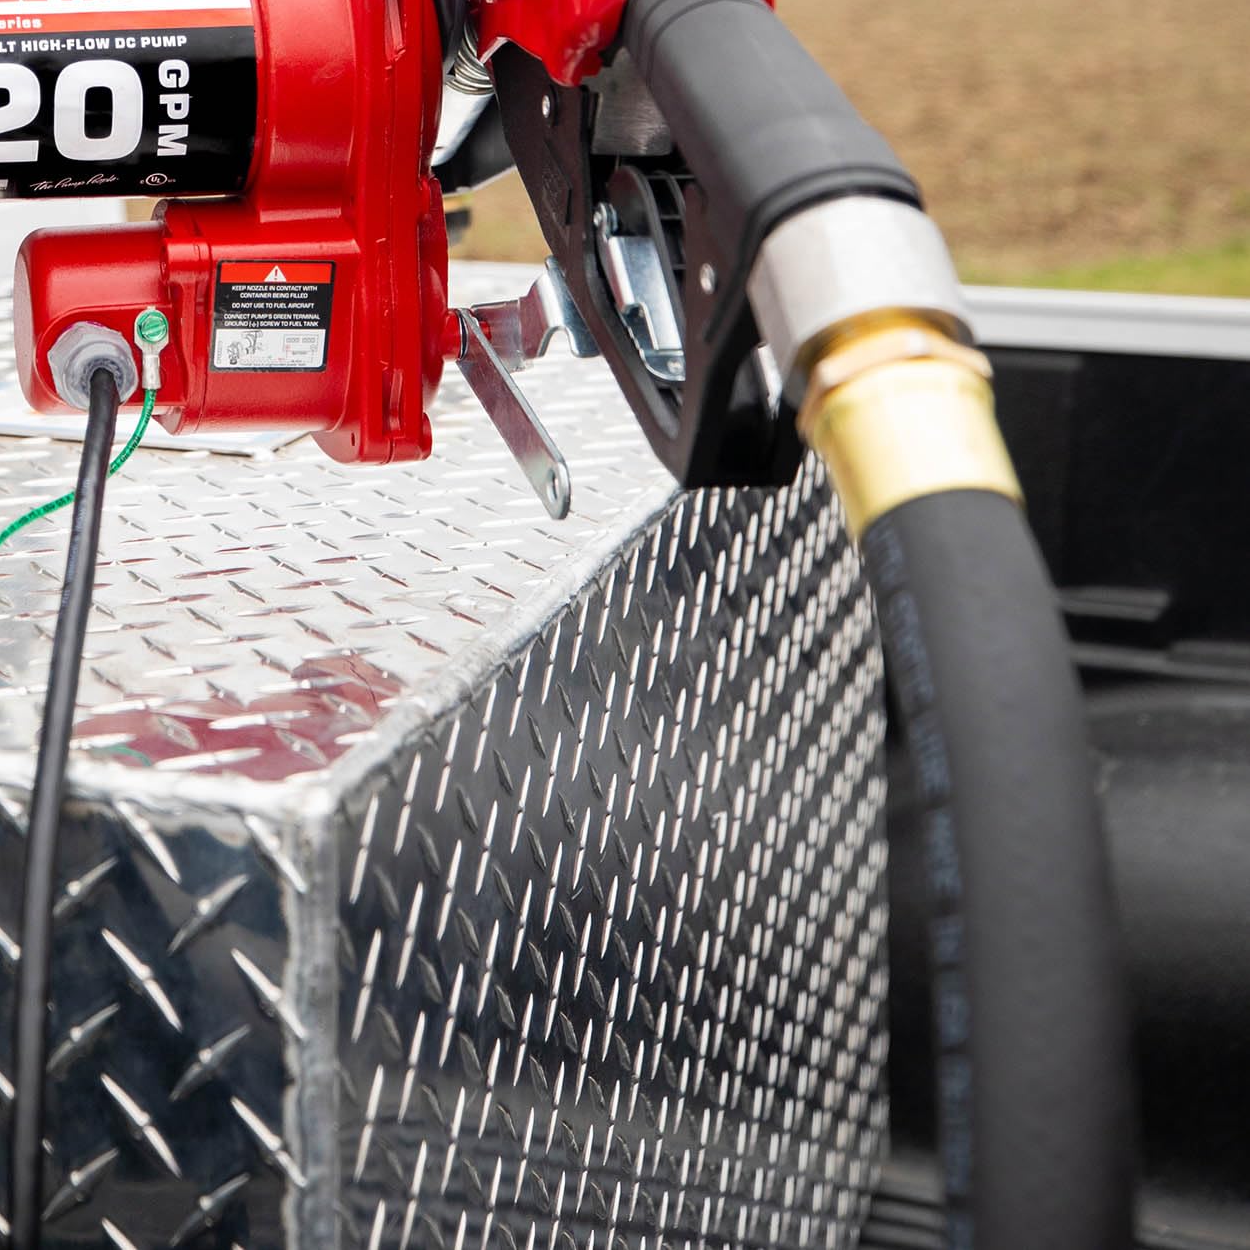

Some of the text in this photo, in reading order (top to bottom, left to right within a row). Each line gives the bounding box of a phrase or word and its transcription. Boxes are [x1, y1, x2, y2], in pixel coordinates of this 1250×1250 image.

[22, 38, 110, 52] HIGH-FLOW
[115, 37, 136, 49] DC
[141, 35, 187, 48] PUMP
[157, 59, 190, 157] GPM
